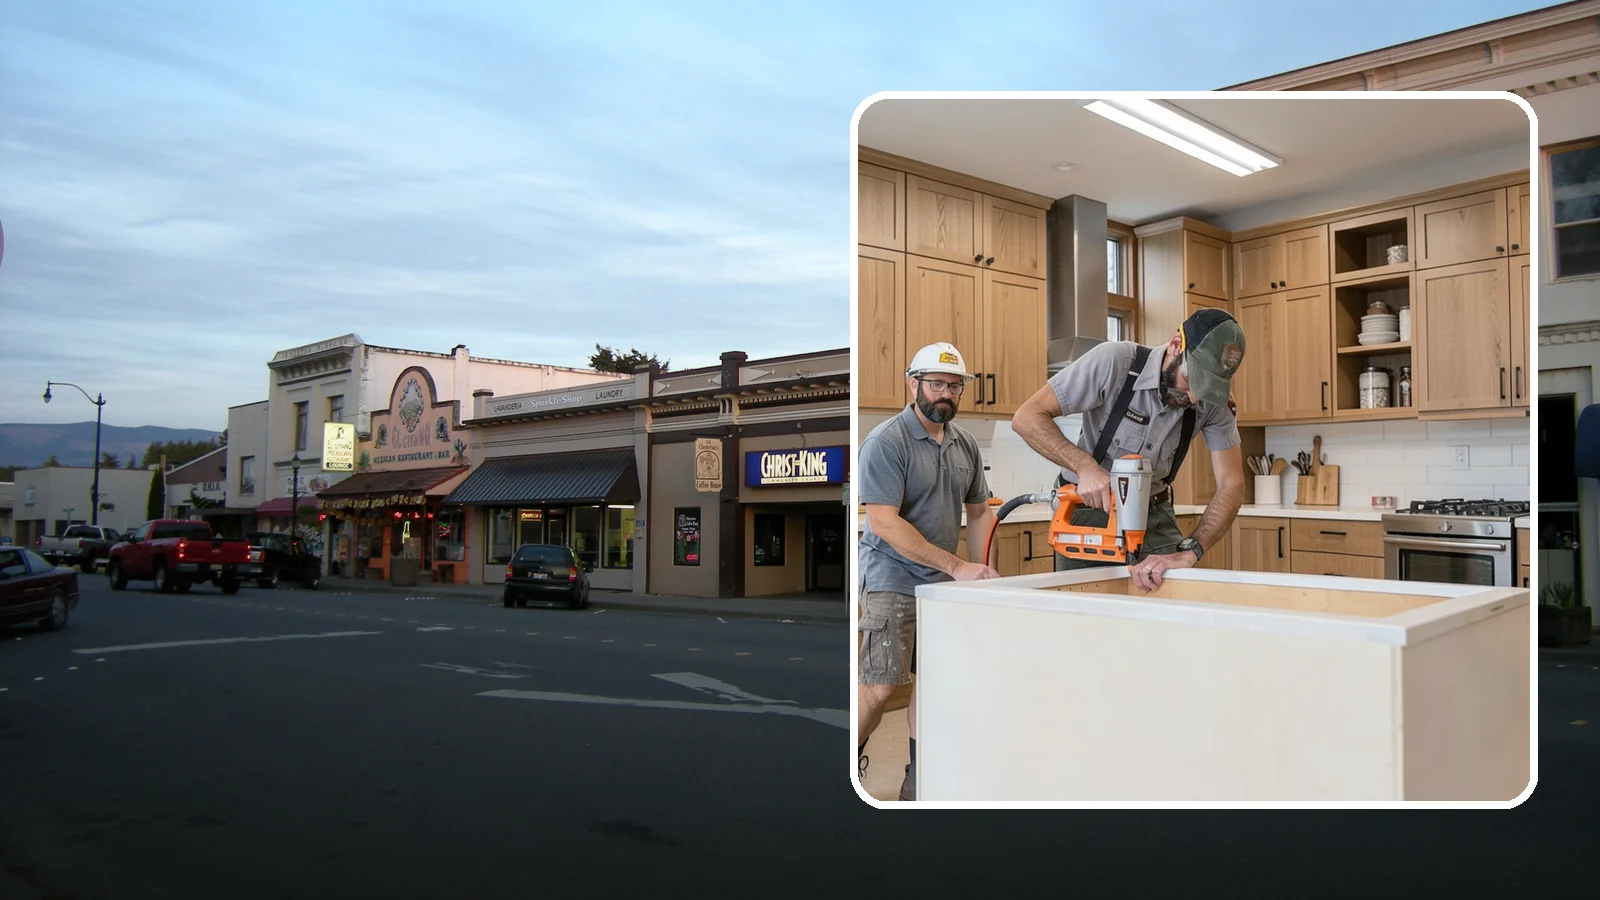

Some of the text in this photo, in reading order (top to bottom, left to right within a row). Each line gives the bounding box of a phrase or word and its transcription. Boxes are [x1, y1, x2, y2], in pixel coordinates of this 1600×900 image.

[561, 395, 582, 405] Shop
[595, 389, 624, 400] LAUNDRY
[493, 402, 523, 413] LAVANDERIA
[374, 455, 396, 464] MEXICAN
[397, 451, 433, 462] RESTAURANT
[438, 450, 450, 459] BAR
[761, 450, 828, 478] CHRIST KING
[710, 481, 722, 489] House
